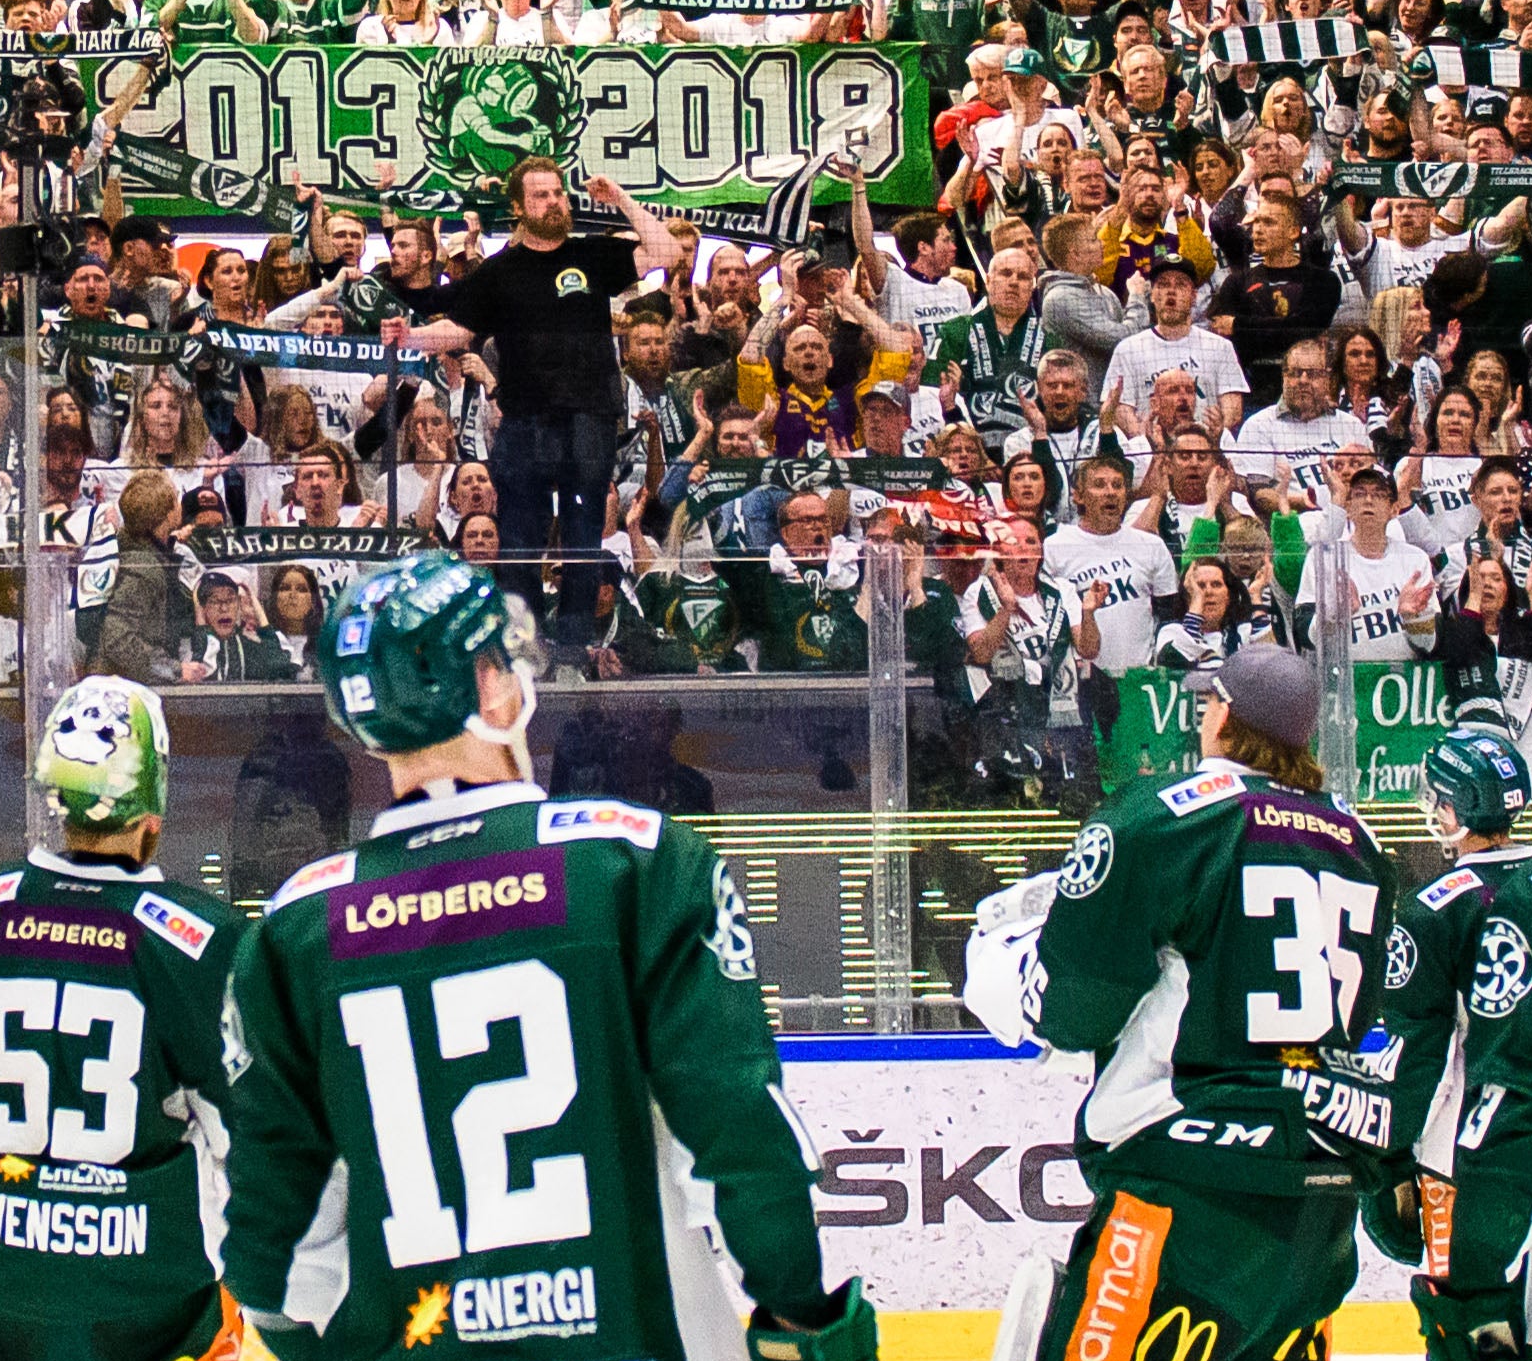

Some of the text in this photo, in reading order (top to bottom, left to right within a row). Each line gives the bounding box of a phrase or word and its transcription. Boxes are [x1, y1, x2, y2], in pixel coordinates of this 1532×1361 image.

[114, 49, 428, 192] 2013
[582, 49, 905, 192] 2018
[210, 326, 385, 362] PÅ DEN SKÖLD DU
[1068, 569, 1109, 588] SOPA
[1351, 606, 1405, 644] FBK
[341, 677, 375, 715] 12
[1173, 783, 1234, 817] ELON
[1504, 790, 1524, 810] 50
[550, 809, 652, 833] ELON
[1255, 803, 1353, 848] LÖFBERGS
[143, 900, 207, 942] ELON
[345, 872, 548, 935] LÖFBERGS
[5, 918, 127, 950] LÖFBERGS
[1246, 862, 1380, 1042] 35
[338, 976, 592, 1269] 12
[453, 1268, 597, 1330] ENERGI
